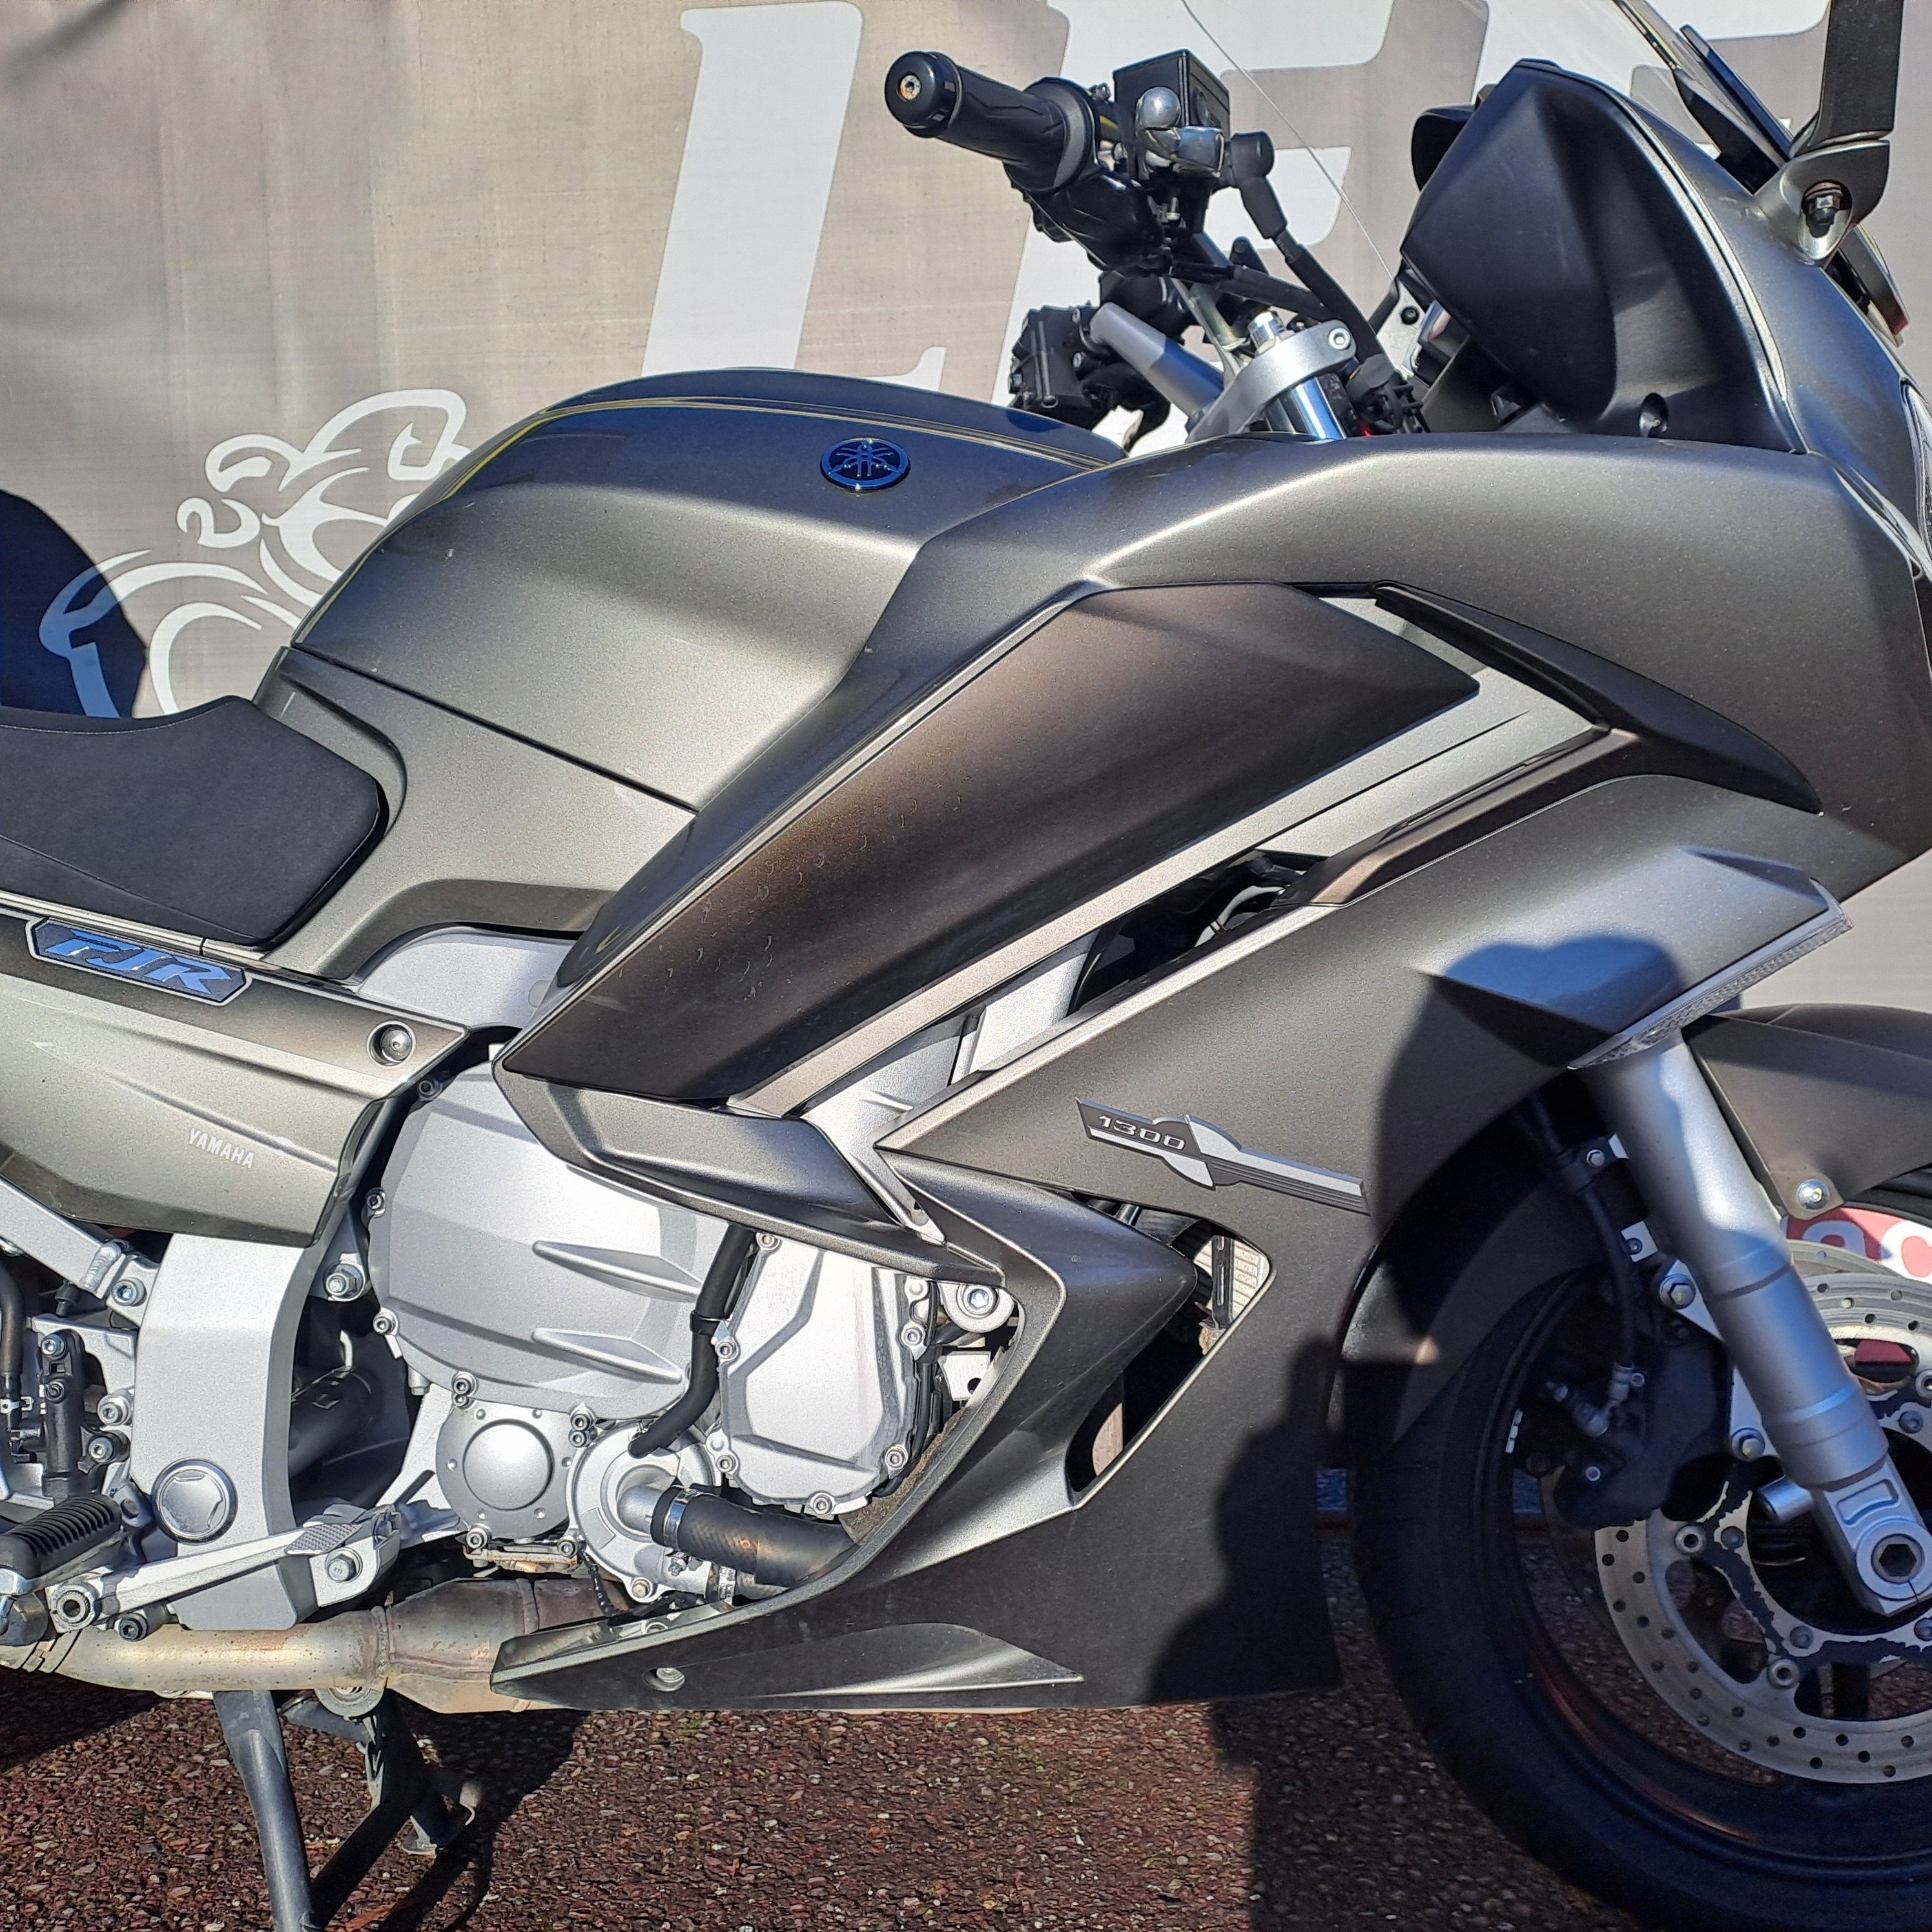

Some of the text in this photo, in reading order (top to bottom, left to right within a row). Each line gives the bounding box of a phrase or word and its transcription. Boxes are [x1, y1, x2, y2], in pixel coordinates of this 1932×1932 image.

[45, 929, 231, 994] FJR
[189, 1127, 255, 1169] YAMAHA
[1099, 1115, 1186, 1150] 1300
